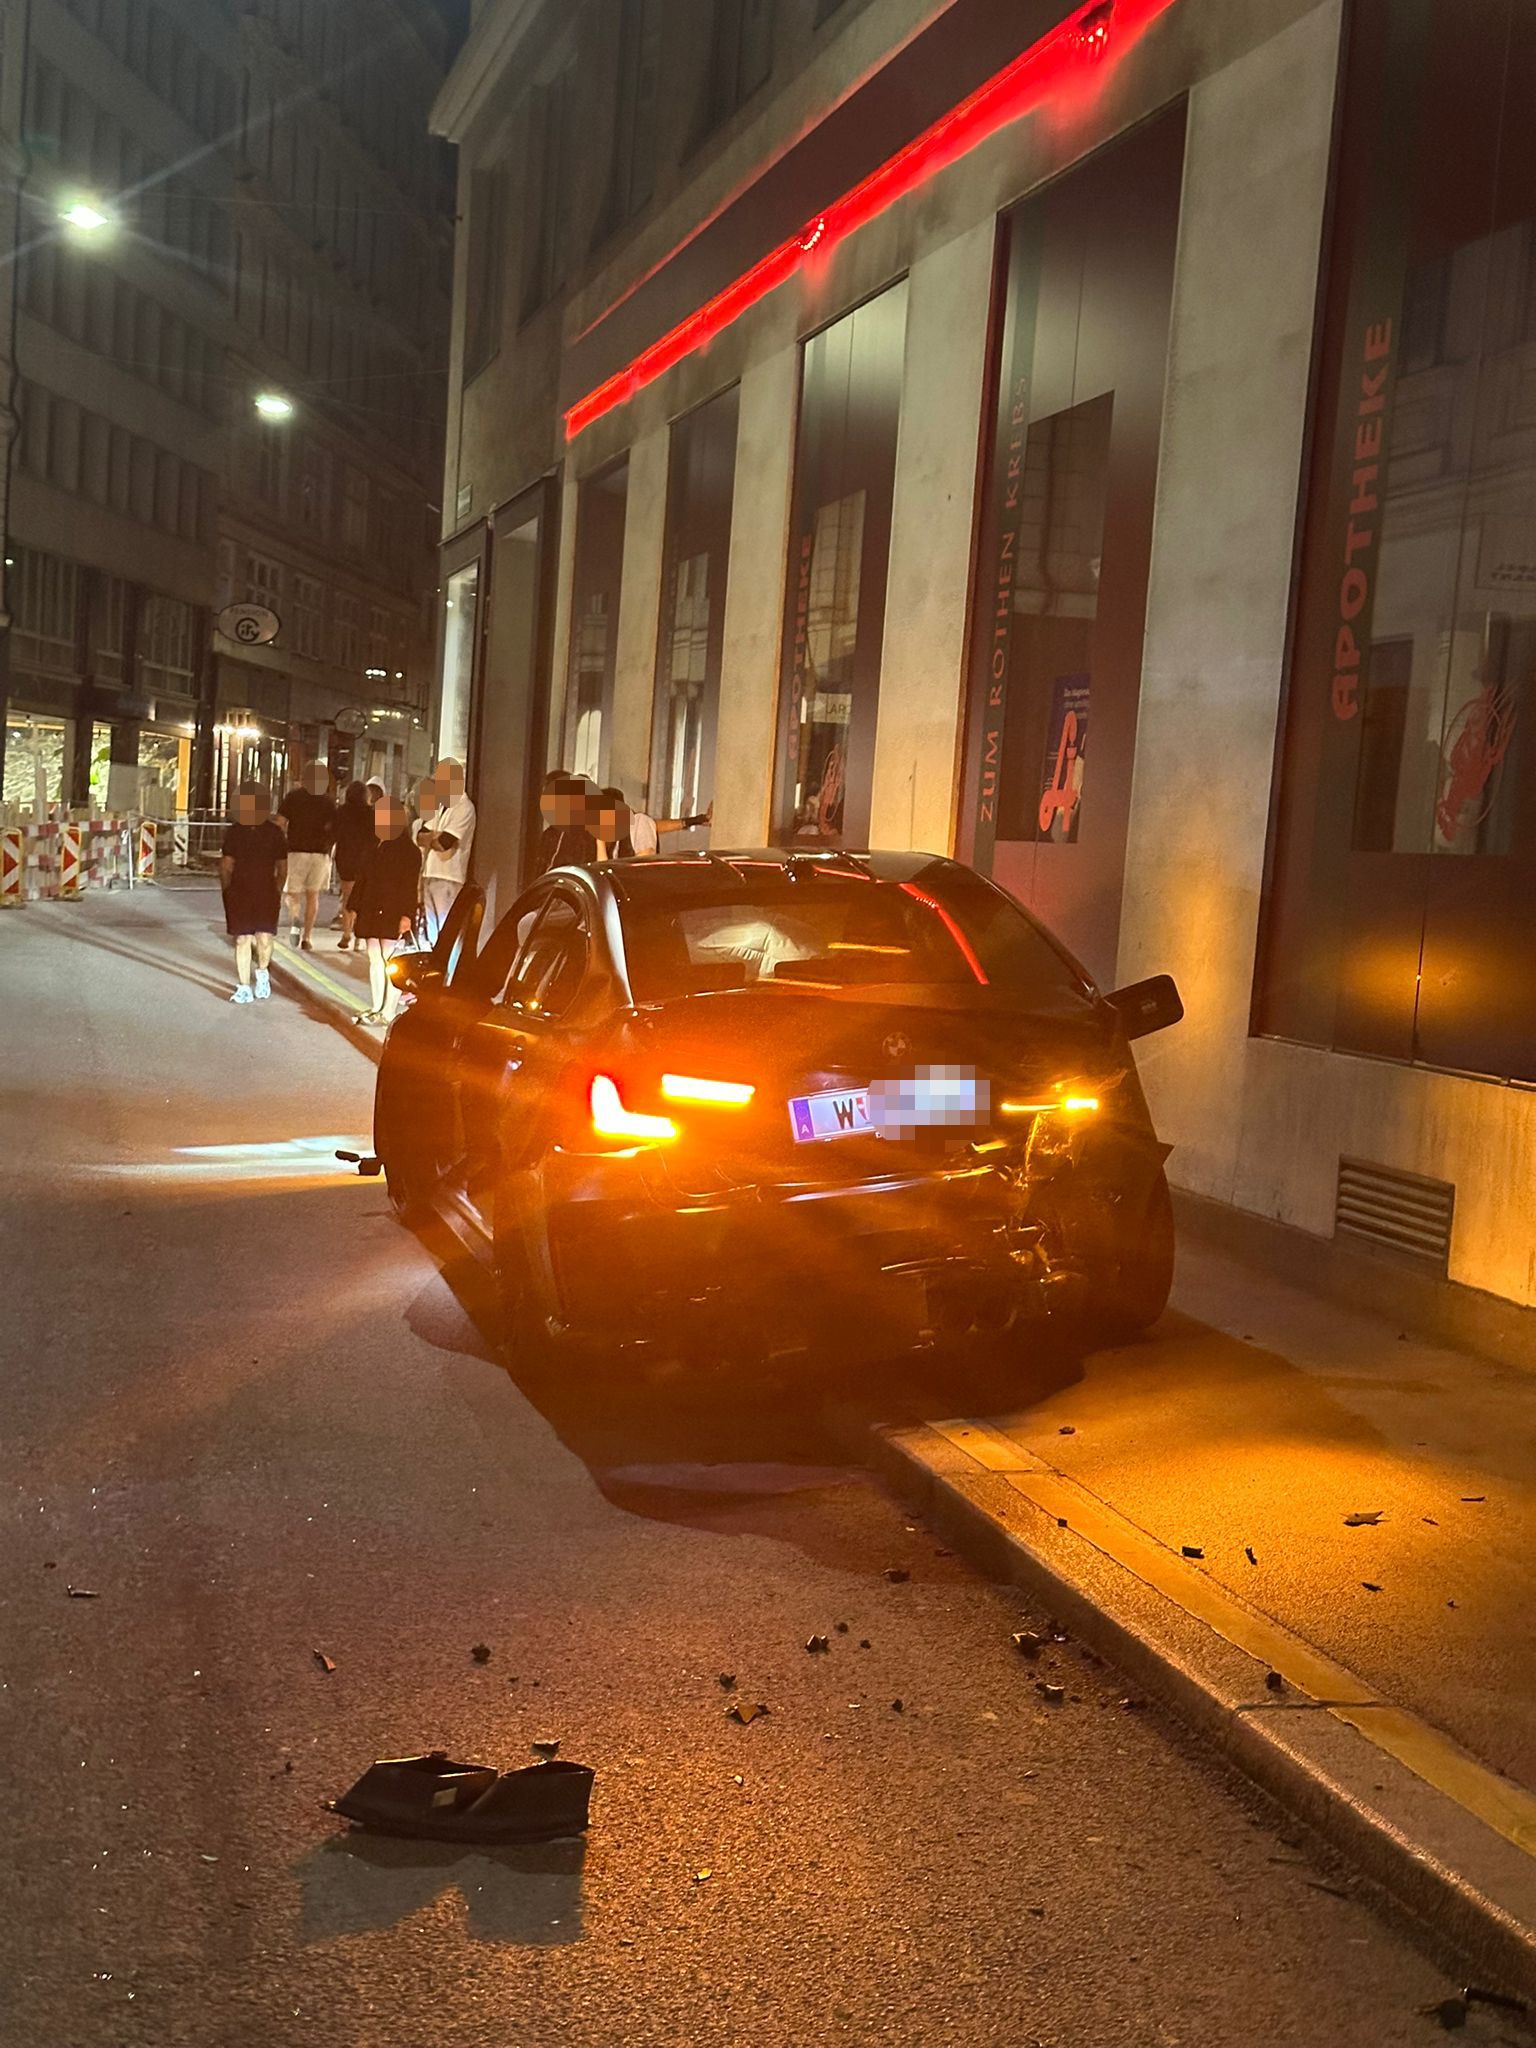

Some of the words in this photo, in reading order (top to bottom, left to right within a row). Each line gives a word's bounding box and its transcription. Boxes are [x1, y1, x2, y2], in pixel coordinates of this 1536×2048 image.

[980, 731, 999, 822] ZUM
[990, 532, 1016, 706] ROTHEN
[1005, 377, 1027, 508] KREBS
[1331, 317, 1393, 721] APOTHEKE
[801, 1124, 810, 1134] A
[832, 1098, 854, 1130] W
